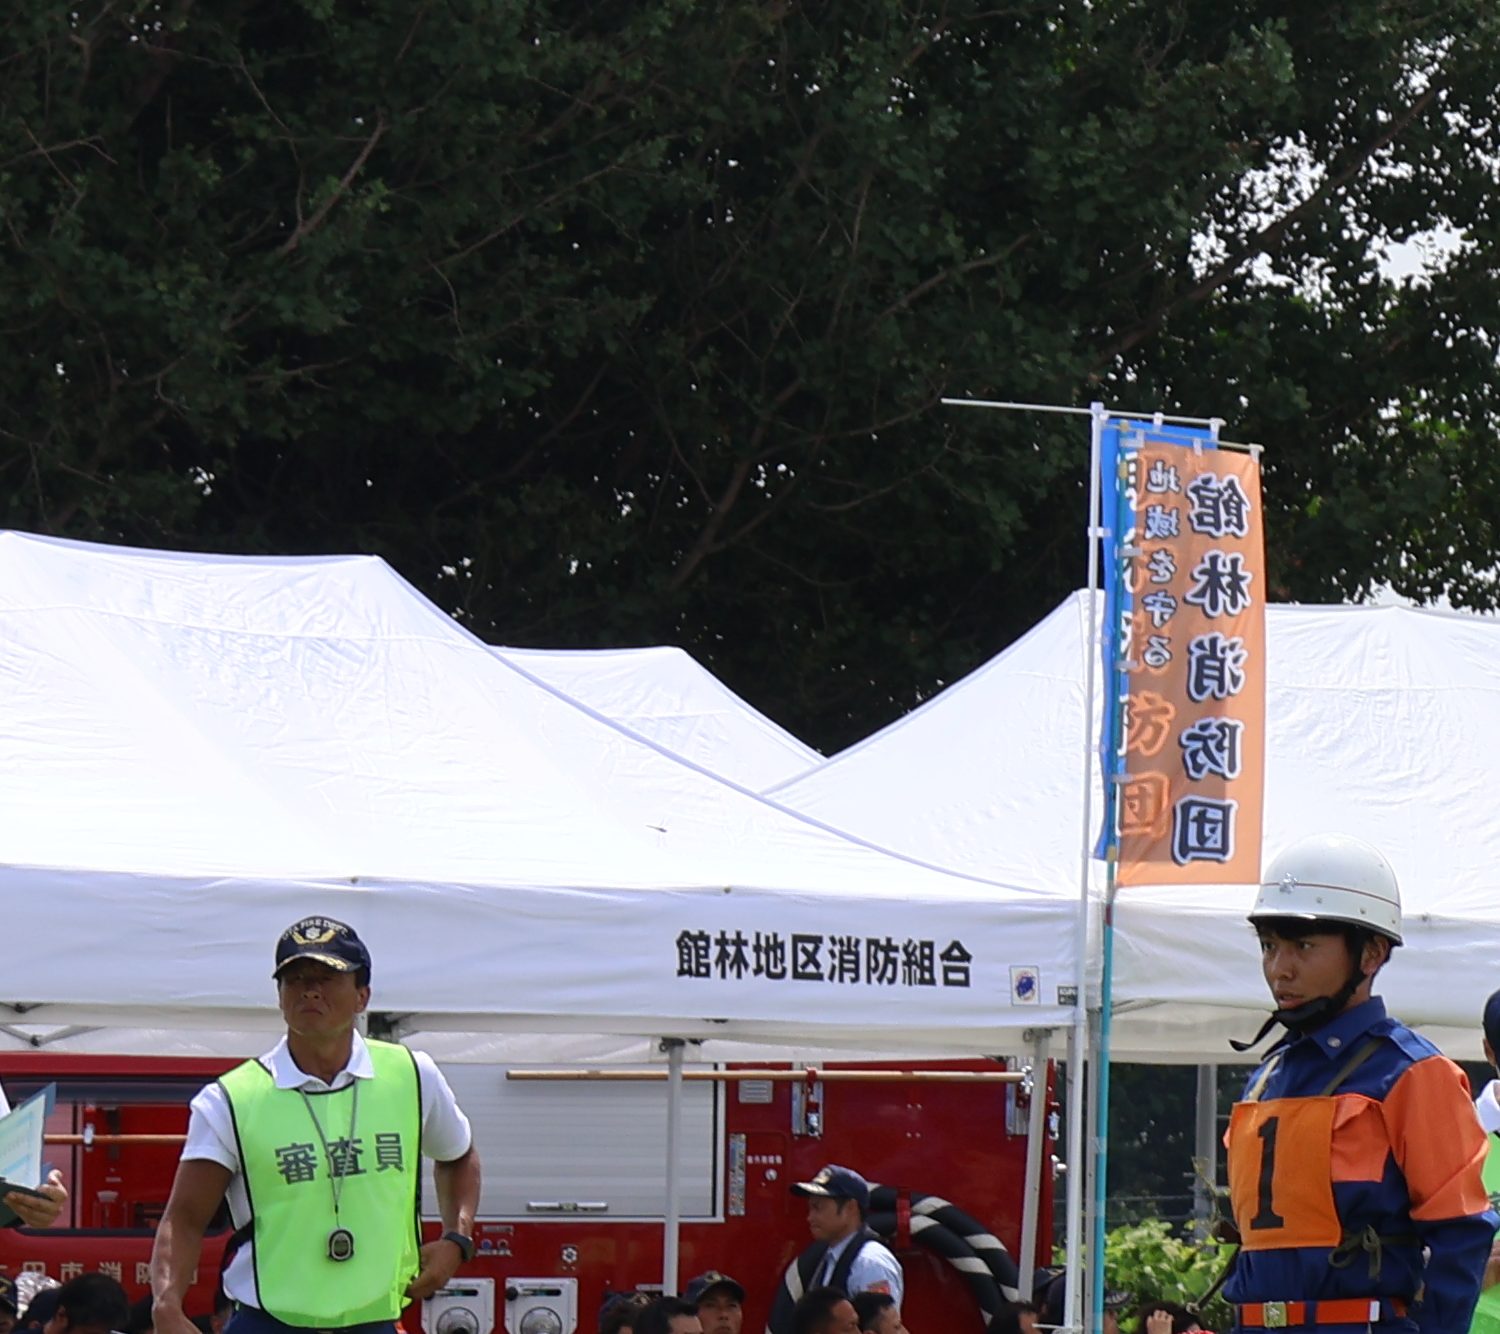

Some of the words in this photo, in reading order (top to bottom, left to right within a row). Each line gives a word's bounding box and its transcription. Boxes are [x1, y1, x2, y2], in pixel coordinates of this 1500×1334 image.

[301, 919, 322, 929] FIRE
[676, 929, 973, 988] 館林地区消防組合
[274, 1132, 404, 1185] 審査員
[1250, 1116, 1284, 1230] 1
